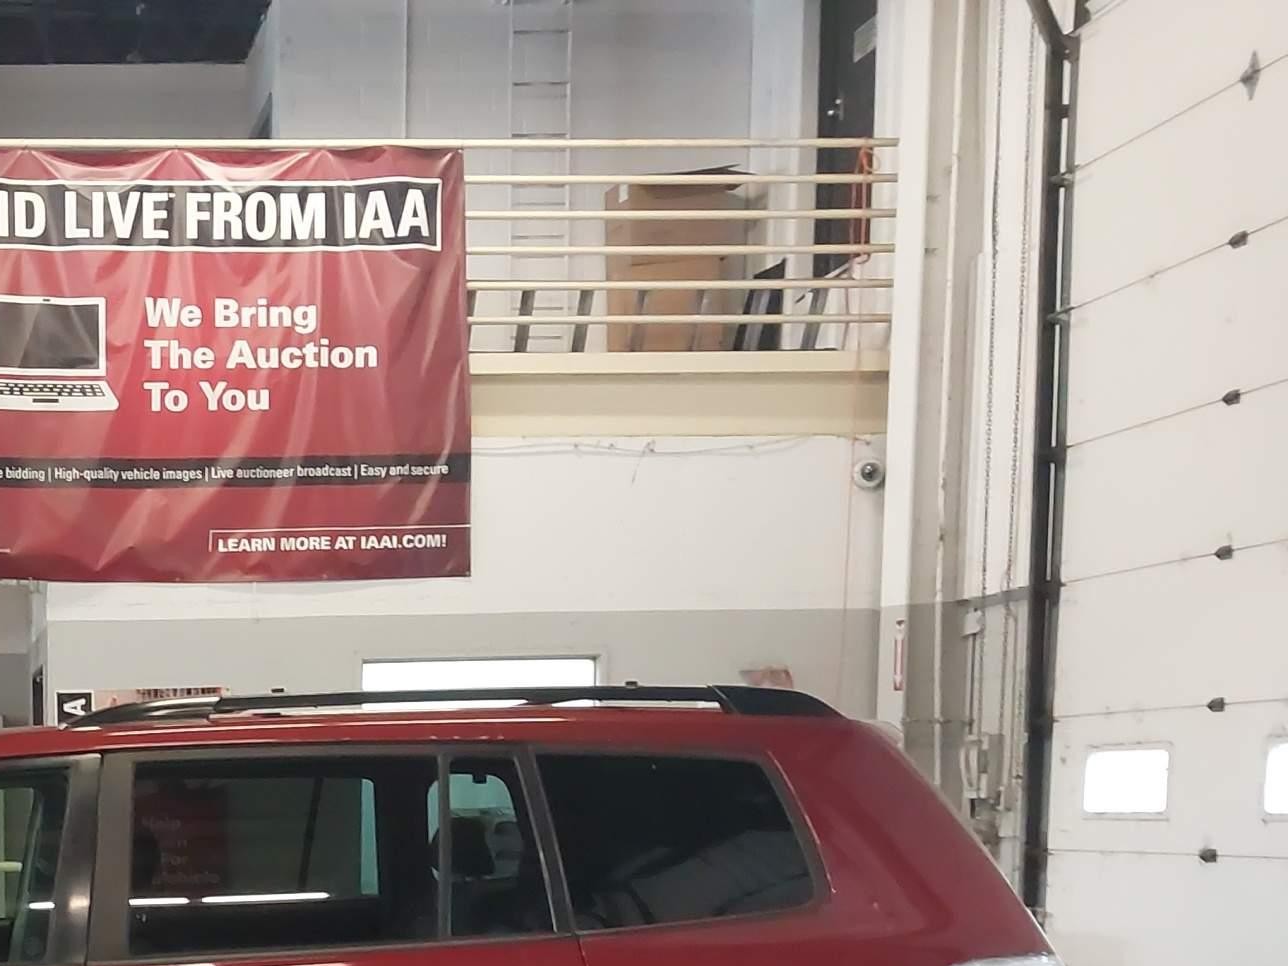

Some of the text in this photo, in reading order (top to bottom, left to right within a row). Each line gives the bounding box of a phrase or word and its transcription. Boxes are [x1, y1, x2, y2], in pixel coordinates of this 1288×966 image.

[64, 190, 170, 239] LIVE
[186, 191, 326, 241] FROM
[343, 188, 430, 239] IAA
[144, 296, 317, 335] We Bring
[143, 338, 378, 369] The Auction
[143, 380, 270, 412] To You
[5, 466, 46, 481] bidding
[54, 466, 120, 482] High-quality
[121, 467, 161, 480] vehicle
[162, 467, 203, 482] images
[211, 465, 234, 479] Live
[236, 465, 295, 479] auctioneer
[296, 464, 353, 477] broadcast
[360, 463, 388, 478] Easy
[389, 463, 410, 476] and
[410, 464, 449, 476] secure
[217, 533, 448, 552] LEARN MORE AT IAAI.COM!
